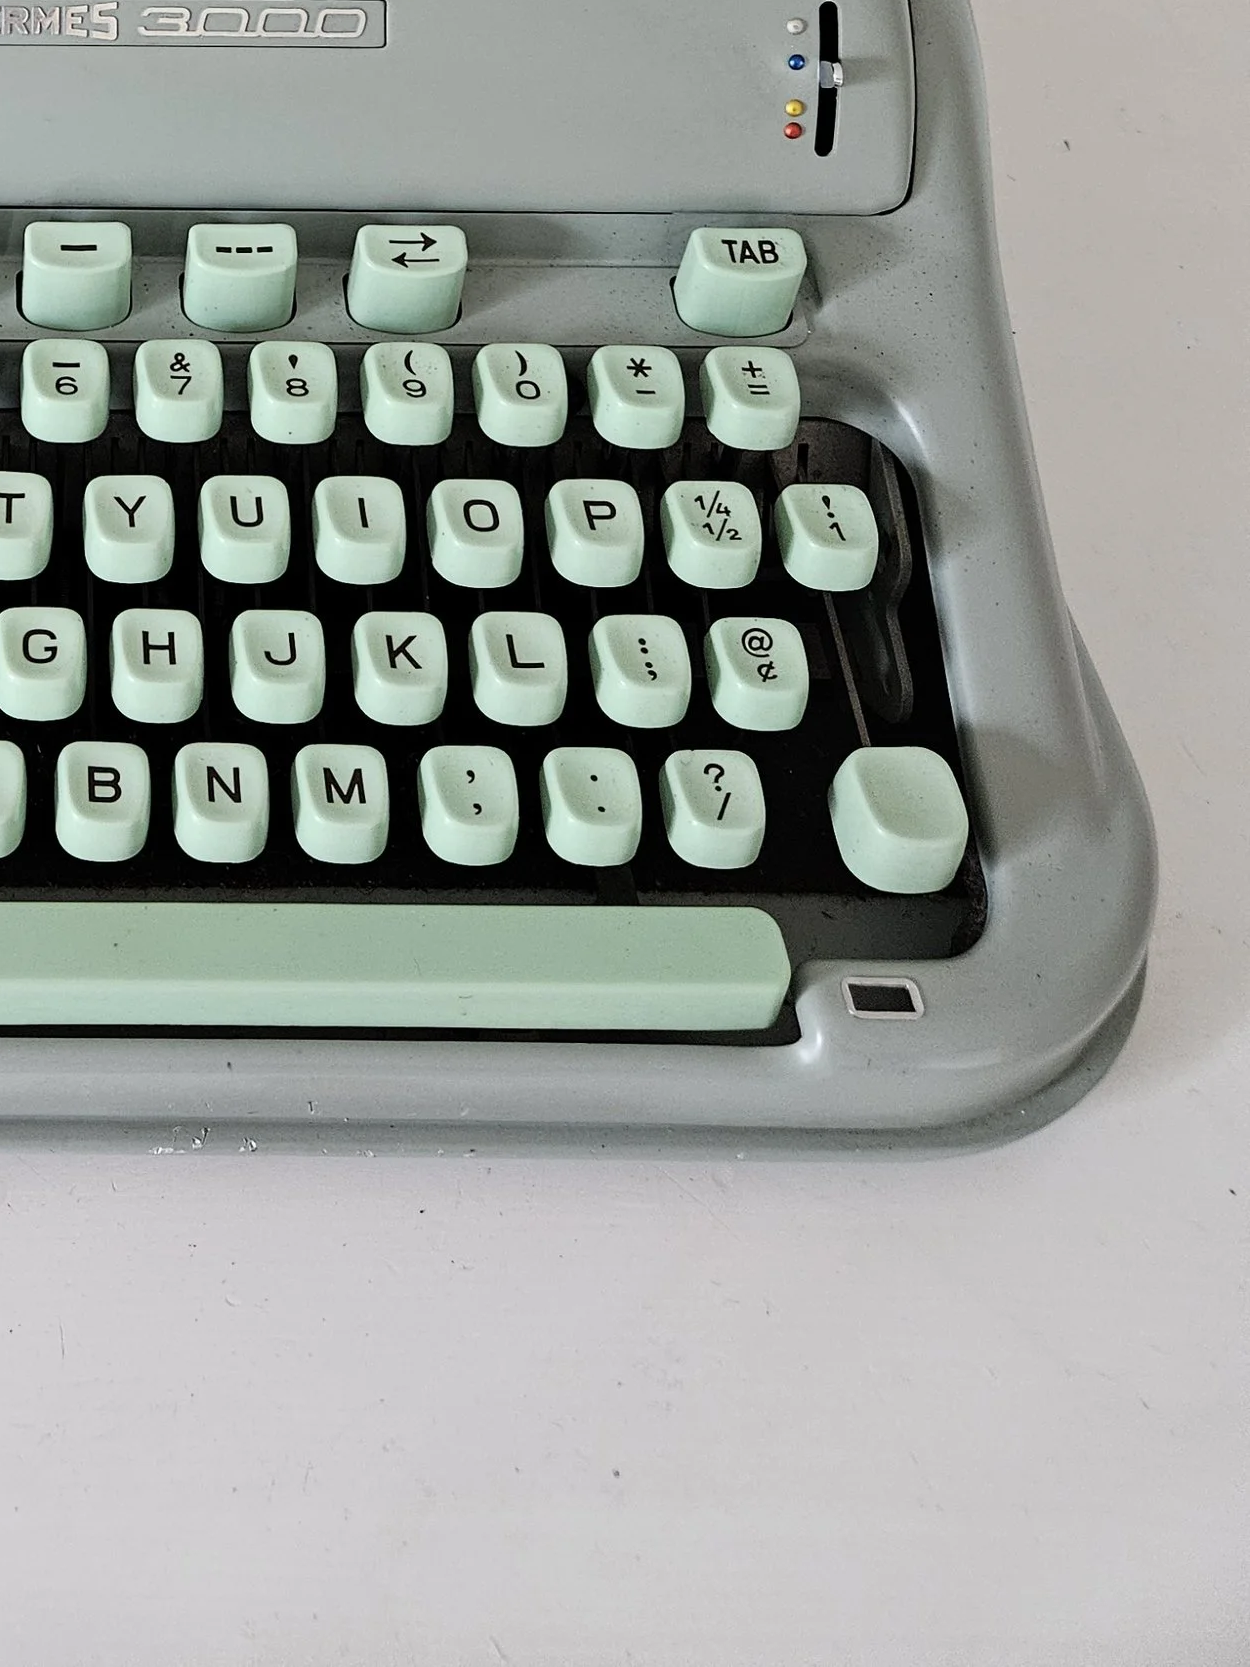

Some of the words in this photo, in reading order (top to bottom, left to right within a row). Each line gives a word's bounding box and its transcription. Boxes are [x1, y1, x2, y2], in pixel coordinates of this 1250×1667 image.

[137, 6, 368, 39] 3000
[721, 239, 779, 264] TAB
[169, 352, 191, 373] &
[55, 376, 79, 395] 6
[170, 375, 192, 395] 7
[286, 378, 309, 397] 8
[402, 379, 427, 398] 9
[114, 496, 146, 527] Y
[230, 496, 263, 527] U
[358, 498, 368, 528] I
[583, 501, 616, 530] P
[23, 629, 57, 664] G
[142, 631, 176, 664] H
[264, 633, 296, 665] J
[386, 635, 422, 669] K
[506, 634, 544, 668] L
[741, 627, 773, 658] @
[88, 766, 121, 803] B
[207, 766, 241, 803] N
[323, 768, 366, 804] M
[703, 763, 725, 792] ?
